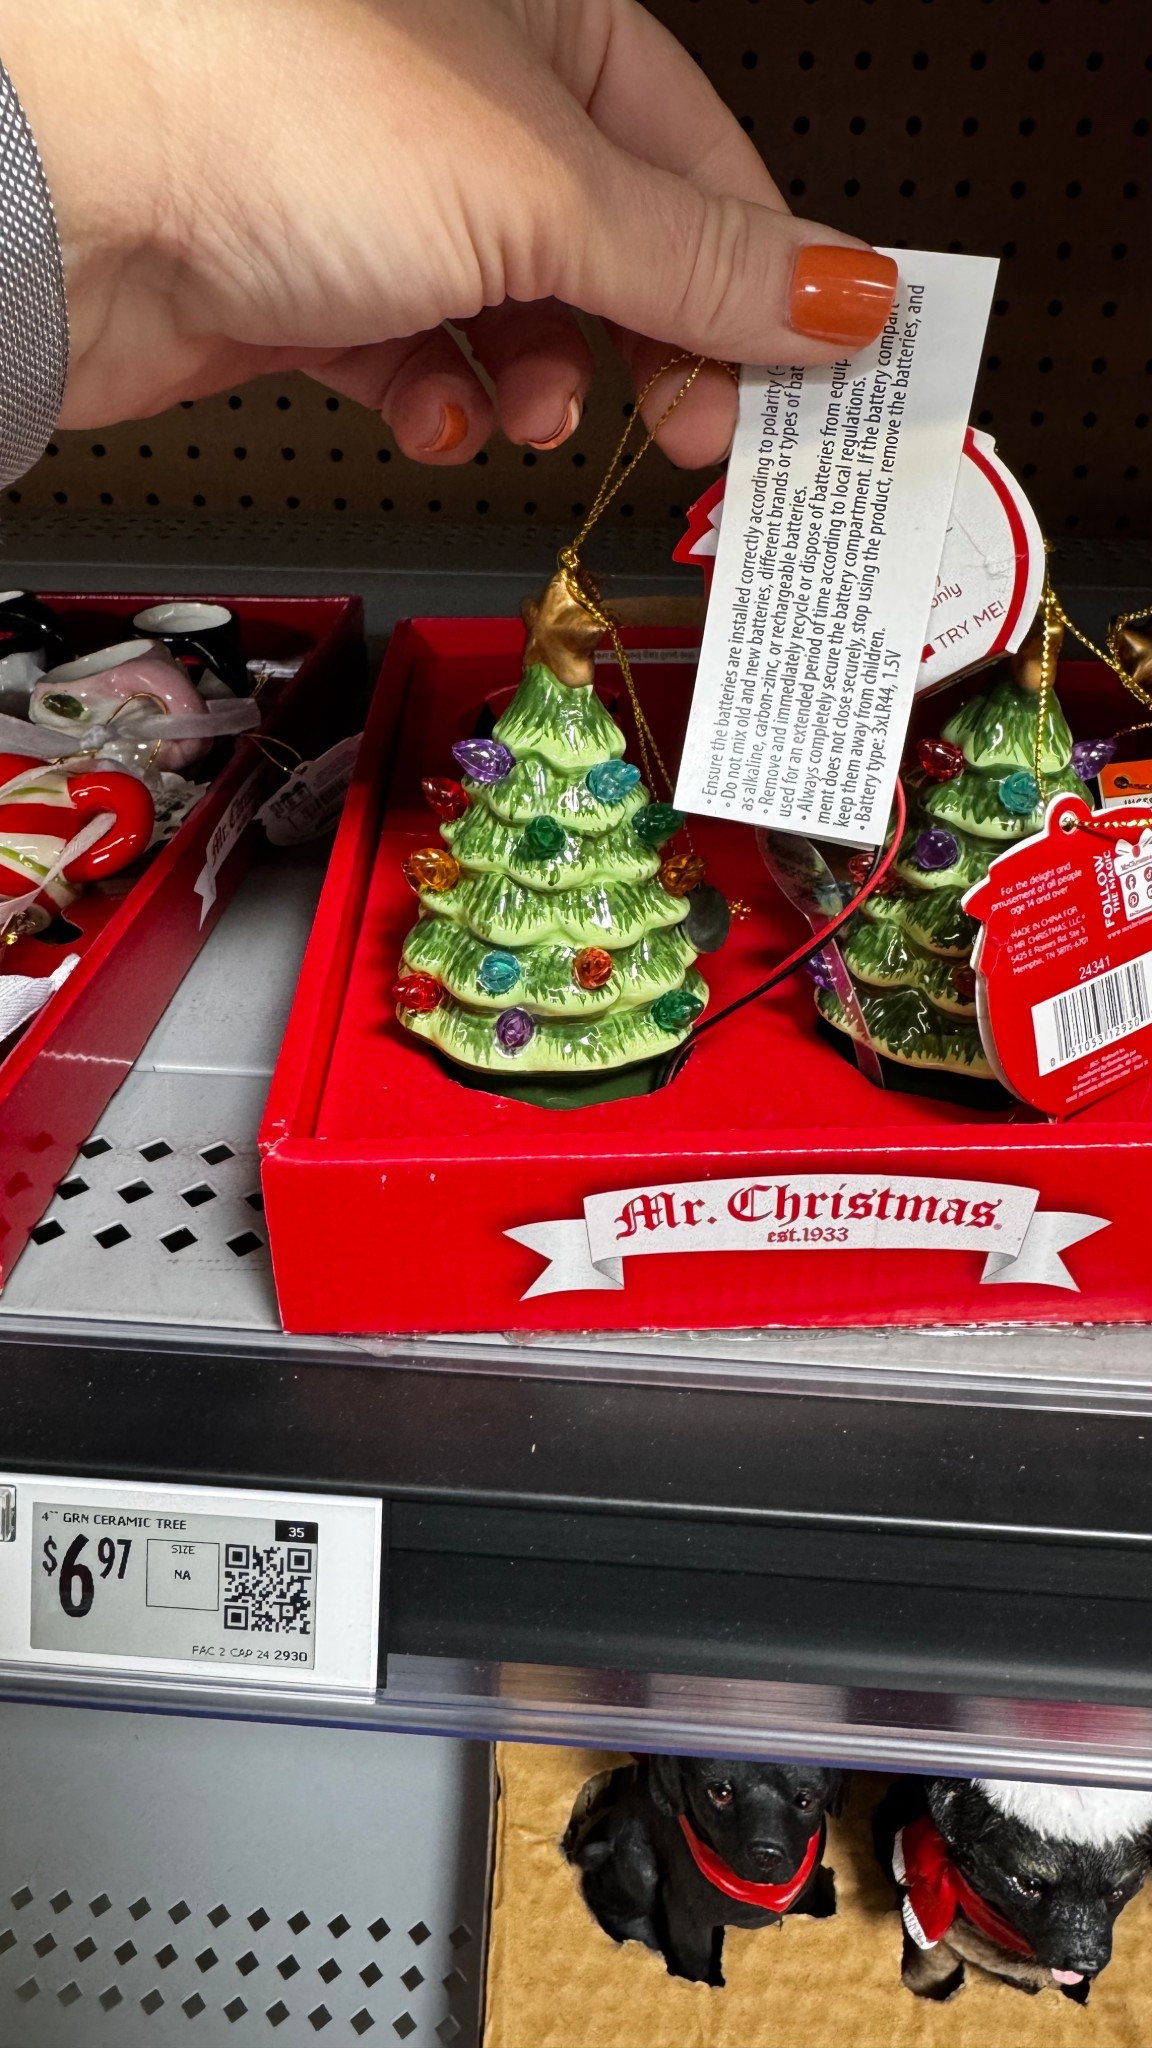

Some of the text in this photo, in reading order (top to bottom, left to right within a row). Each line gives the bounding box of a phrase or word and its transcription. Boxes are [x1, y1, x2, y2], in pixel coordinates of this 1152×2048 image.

[761, 380, 787, 436] polarity
[821, 403, 841, 437] from
[865, 370, 893, 424] battery
[758, 439, 774, 454] to
[858, 452, 875, 465] If
[861, 426, 879, 451] the
[750, 457, 775, 524] according
[810, 439, 835, 502] batteries
[809, 503, 825, 519] of
[844, 469, 872, 567] compartment.
[741, 526, 764, 584] correctly
[799, 522, 825, 574] dispose
[818, 285, 925, 824] ment does not close securely, stop using the product, remove the batteries, and
[720, 366, 805, 799] Do not mix old and new batteries, different brands or types of bat
[779, 377, 867, 817] used for an extended period of time according to local regulations.
[799, 576, 813, 591] or
[831, 570, 859, 620] battery
[728, 587, 751, 644] installed
[791, 594, 813, 641] recycle
[828, 622, 846, 644] the
[934, 600, 1007, 649] TRY ME!
[728, 647, 742, 668] are
[742, 486, 808, 811] as alkaline, carbon-zinc, or rechargeable batteries.
[823, 648, 841, 691] secure
[714, 670, 738, 726] batteries
[773, 642, 806, 724] immediately
[710, 730, 728, 751] the
[772, 727, 787, 752] and
[809, 692, 837, 764] completely
[833, 628, 886, 827] keep them away from children.
[855, 649, 901, 822] Battery type: 3xLR44, 1.5V
[702, 754, 723, 796] Ensure
[758, 755, 782, 806] Remove
[797, 767, 823, 813] Always
[1001, 862, 1071, 896] For the delight and
[1010, 904, 1025, 915] age
[1036, 892, 1051, 904] and
[1052, 886, 1068, 898] over
[1047, 879, 1056, 889] all
[1057, 870, 1082, 886] people
[1093, 856, 1115, 929] FOLLOW
[1104, 850, 1121, 914] THE MAGIC
[1041, 913, 1063, 927] CHINA
[1063, 906, 1078, 917] FOR
[1079, 955, 1110, 980] 24341
[1050, 1057, 1056, 1068] 0
[1109, 1016, 1140, 1040] 12930
[614, 1191, 717, 1240] Mr.
[767, 1226, 849, 1243] est.1933
[63, 1512, 89, 1524] GRN
[93, 1514, 151, 1528] CERAMIC
[156, 1518, 187, 1530] TREE
[288, 1527, 305, 1538] 35
[171, 1544, 195, 1555] SIZE
[174, 1569, 191, 1580] NA
[192, 1645, 215, 1656] FAC
[219, 1647, 226, 1657] 2
[257, 1649, 269, 1660] 24
[274, 1650, 308, 1662] 2930
